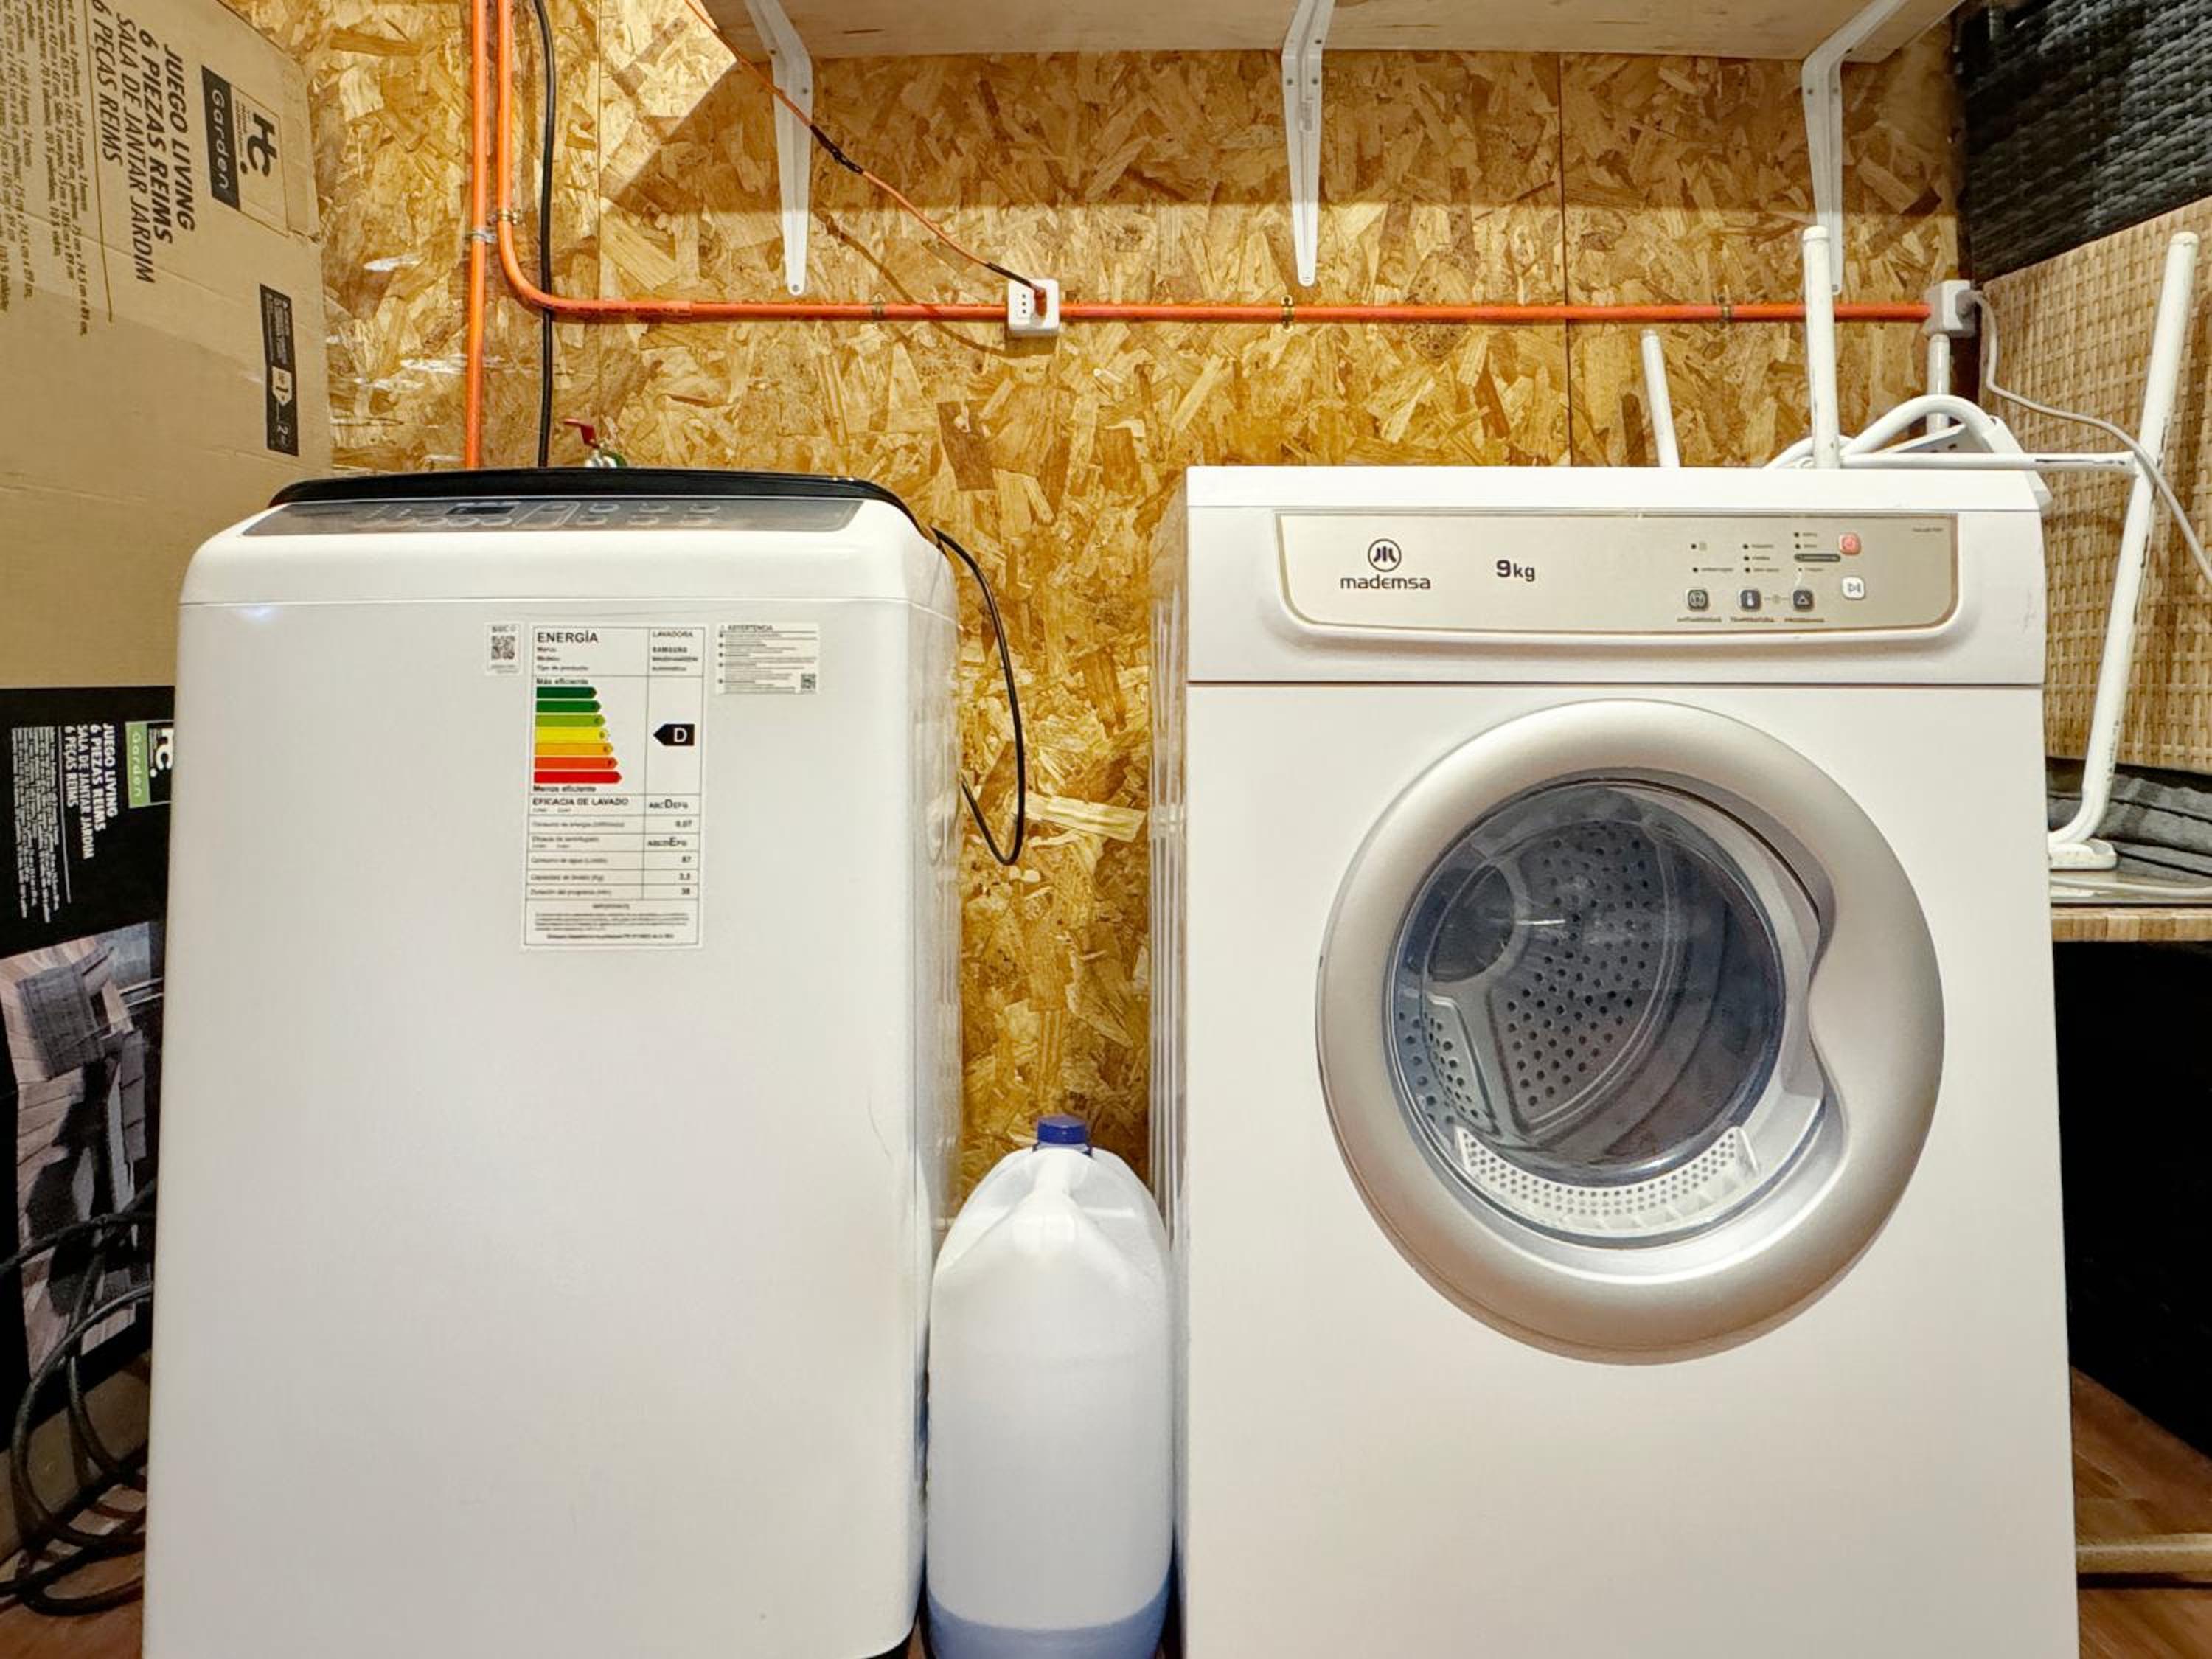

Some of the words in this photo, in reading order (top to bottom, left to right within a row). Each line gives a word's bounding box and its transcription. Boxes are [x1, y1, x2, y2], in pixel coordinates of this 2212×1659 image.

[92, 0, 112, 16] 6
[90, 19, 117, 91] PEÇAS
[116, 13, 139, 69] SALA
[139, 29, 158, 49] 6
[122, 73, 142, 108] DE
[142, 55, 166, 152] PIEZAS
[164, 44, 187, 133] JUEGO
[99, 93, 122, 166] REIMS
[124, 107, 147, 194] JANTAR
[212, 89, 229, 189] Garden
[150, 156, 173, 243] REIMS
[172, 139, 195, 231] LIVING
[130, 195, 156, 283] JARDIM
[1340, 574, 1431, 589] mademsa
[537, 630, 599, 644] ENERGÍA
[65, 726, 76, 734] 6
[77, 724, 88, 752] SALA
[90, 723, 101, 734] 6
[102, 722, 115, 768] JUEGO
[673, 727, 688, 743] D
[63, 737, 77, 771] PEÇAS
[78, 754, 90, 769] DE
[91, 737, 104, 785] PIEZAS
[132, 731, 142, 797] Garden
[66, 773, 78, 807] REIMS
[78, 773, 91, 814] JANTAR
[93, 788, 106, 832] REIMS
[105, 771, 117, 818] LIVING
[532, 797, 575, 806] EFICACIA
[591, 797, 629, 805] LAVADO
[80, 816, 94, 860] JARDIM
